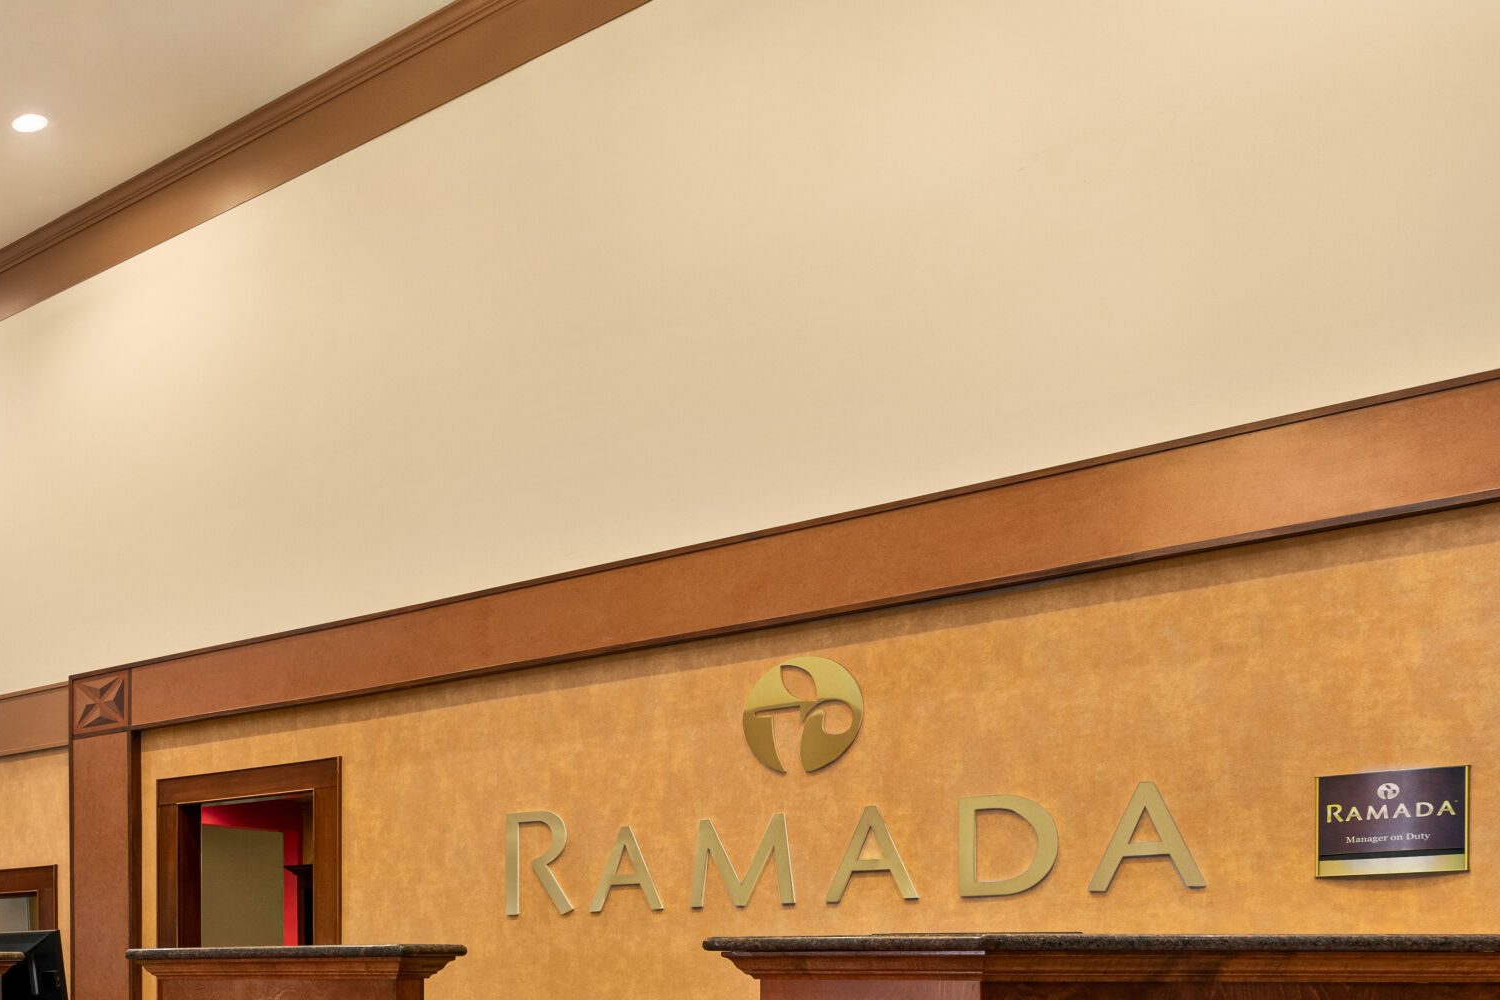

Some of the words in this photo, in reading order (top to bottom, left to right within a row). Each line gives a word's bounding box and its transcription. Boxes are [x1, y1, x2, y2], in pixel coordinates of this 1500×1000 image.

[1326, 800, 1457, 824] RAMADA
[505, 781, 1207, 917] RAMADA
[1345, 835, 1388, 845] Manager
[1390, 834, 1403, 842] on
[1406, 832, 1431, 842] Duty
